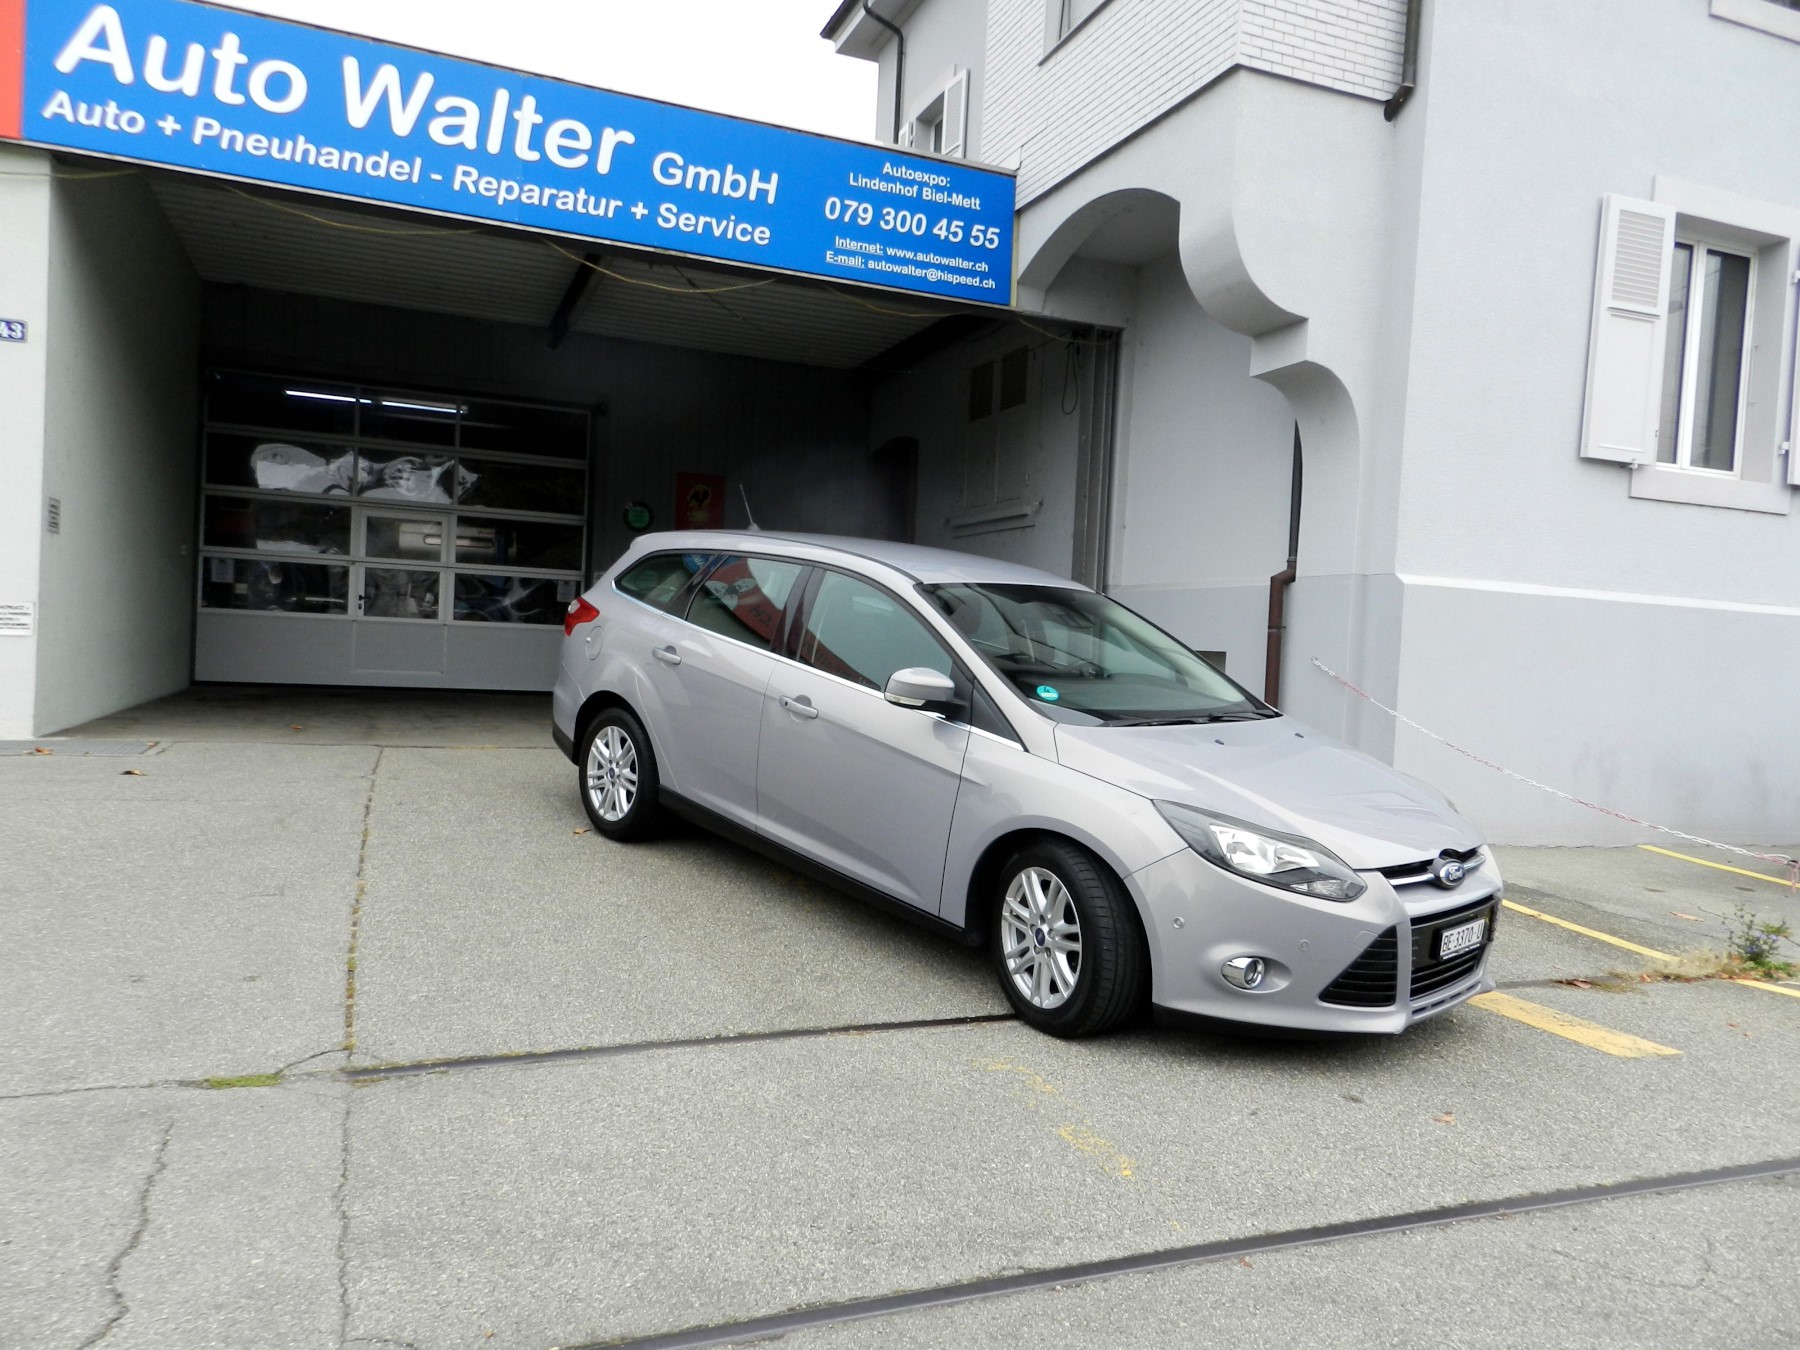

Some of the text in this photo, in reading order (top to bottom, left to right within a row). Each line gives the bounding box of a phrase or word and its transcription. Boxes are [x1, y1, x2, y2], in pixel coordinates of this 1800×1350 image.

[53, 4, 779, 206] Auto Walter GmbH
[41, 91, 146, 136] Auto
[156, 114, 182, 137] +
[192, 116, 422, 185] Pneuhandel
[453, 164, 623, 220] Reparatur
[630, 201, 649, 221] +
[657, 201, 771, 246] Service
[882, 162, 951, 187] Autoexpo:
[849, 172, 981, 211] Lindenhof Biel-Mett
[824, 196, 1001, 250] 079 300 45 55
[825, 250, 996, 290] E-mail: autowalter@hispeed.ch
[834, 236, 989, 273] Internet: www.autowalter.ch
[1448, 865, 1463, 881] Ford
